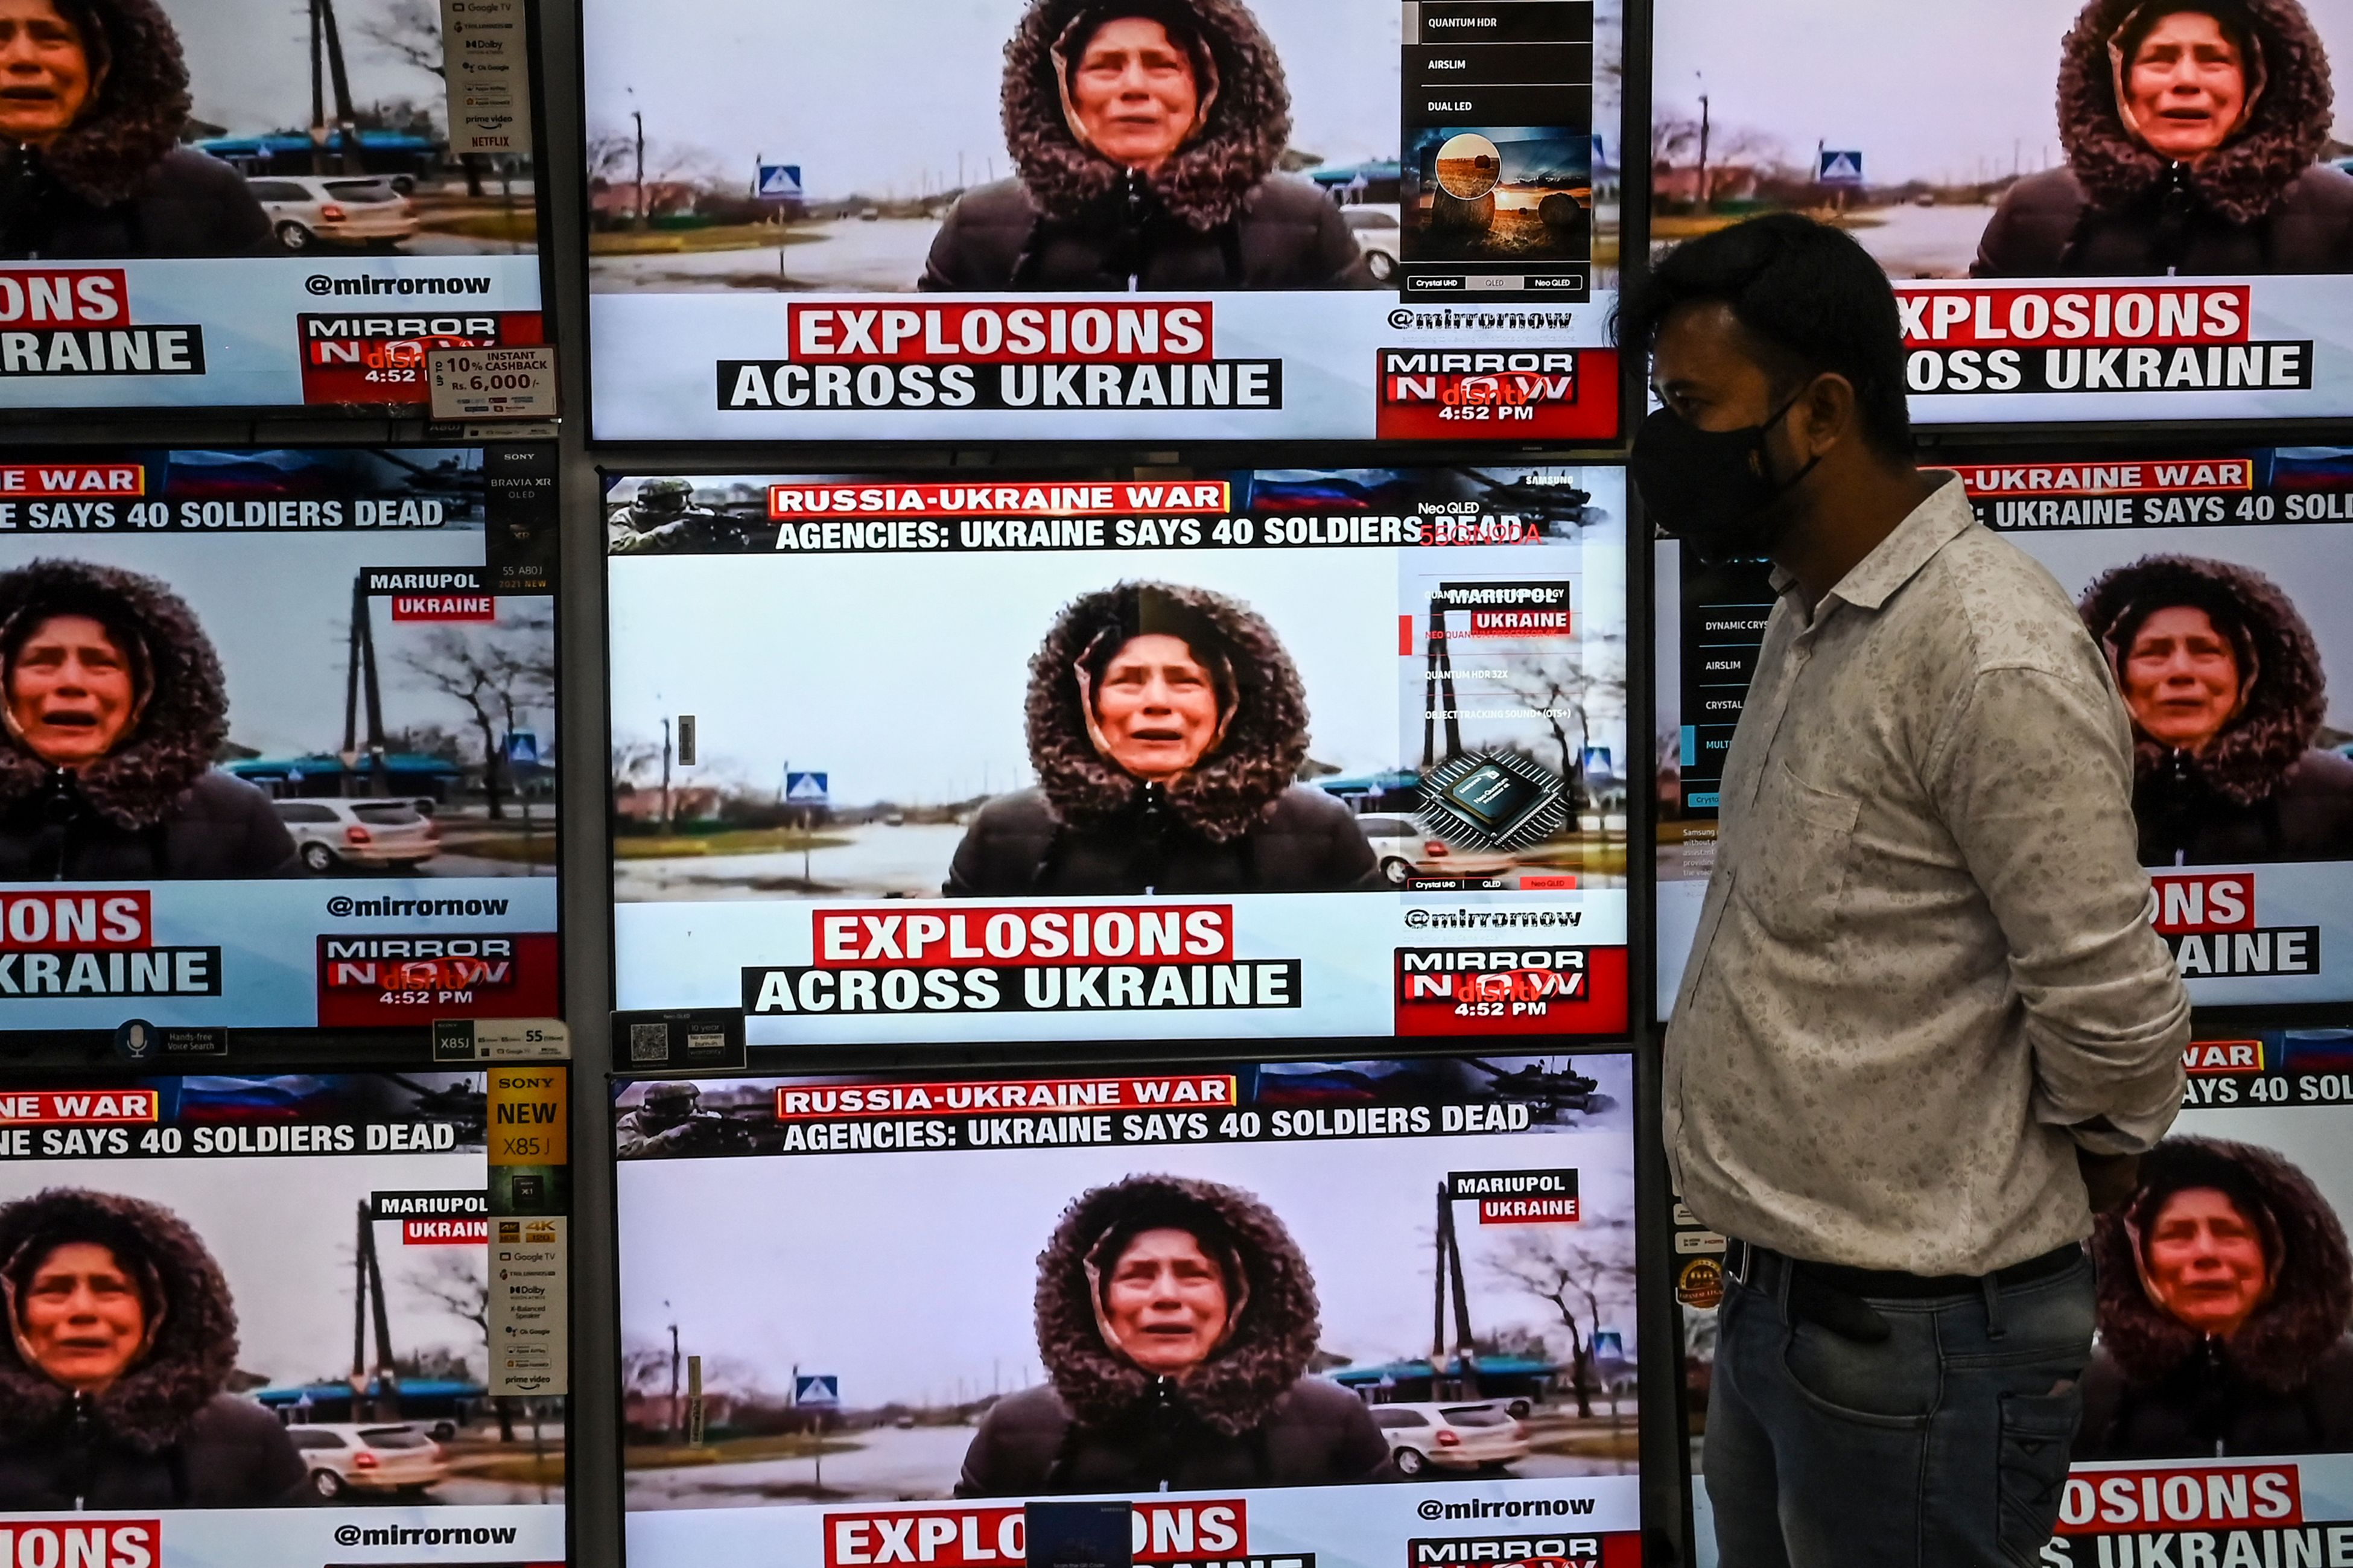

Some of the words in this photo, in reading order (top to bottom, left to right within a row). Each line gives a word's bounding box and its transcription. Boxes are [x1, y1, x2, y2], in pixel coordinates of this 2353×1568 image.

[1428, 18, 1475, 28] QUANTUM
[1478, 18, 1497, 27] HDR
[478, 40, 503, 49] Dolby
[1428, 60, 1466, 69] AIRSLIM
[1428, 102, 1452, 111] DUAL
[1455, 102, 1472, 111] LED
[472, 136, 509, 147] NETFLIX
[305, 274, 491, 296] @mirrornow
[1899, 292, 2241, 340] XPLOSIONS
[309, 318, 495, 337] MIRROR
[799, 309, 1204, 355] EXPLOSIONS
[487, 352, 536, 361] INSTANT
[1387, 354, 1573, 373] MIRROR
[436, 361, 443, 372] TO
[485, 361, 548, 371] CASHBACK
[1905, 349, 2022, 392] OSS
[2045, 346, 2301, 389] UKRAINE
[365, 369, 416, 383] 4:52
[436, 375, 444, 386] UP
[452, 382, 467, 391] Rs.
[730, 364, 976, 407] ACROSS
[1000, 364, 1270, 407] UKRAINE
[1438, 407, 1490, 421] 4:52
[1499, 407, 1534, 421] PM
[39, 470, 134, 490] WAR
[1526, 475, 1573, 485] SAMSUNG
[1964, 466, 2142, 492] -UKRAINE
[2155, 464, 2243, 486] WAR
[778, 487, 1114, 512] RUSSIA-UKRAINE
[1126, 486, 1219, 508] WAR
[29, 502, 115, 528] SAYS
[127, 501, 169, 528] 40
[181, 500, 343, 527] SOLDIERS
[355, 500, 444, 527] DEAD
[1418, 503, 1446, 514] Neo
[1447, 501, 1480, 514] QLED
[1995, 498, 2133, 527] UKRAINE
[2144, 497, 2225, 524] SAYS
[2236, 495, 2275, 521] 40
[776, 521, 950, 550] AGENCIES:
[960, 519, 1105, 548] UKRAINE
[1116, 518, 1202, 546] SAYS
[1211, 518, 1254, 545] 40
[1264, 516, 1423, 544] SOLDIERS
[503, 567, 514, 576] 55
[519, 566, 542, 575] A80J
[370, 574, 480, 589] MARIUPOL
[1449, 588, 1557, 605] MARIUPOL
[399, 597, 490, 613] UKRAINE
[1476, 612, 1567, 628] UKRAINE
[1706, 621, 1746, 630] DYNAMIC
[1425, 631, 1444, 640] NEO
[1706, 661, 1741, 670] AIRSLIM
[1424, 671, 1470, 680] QUANTUM
[1472, 670, 1490, 679] HDR
[1491, 670, 1508, 679] 32X
[1706, 700, 1743, 709] CRYSTAL
[1424, 711, 1458, 720] OBJECT
[1460, 710, 1504, 719] TRACKING
[1415, 881, 1441, 890] Crystal
[326, 896, 509, 917] @mirrornow
[0, 898, 142, 943] ONS
[824, 910, 1225, 960] EXPLOSIONS
[327, 939, 510, 958] MIRROR
[2176, 932, 2308, 974] AINE
[1404, 951, 1584, 971] MIRROR
[755, 968, 1000, 1012] ACROSS
[1024, 964, 1289, 1008] UKRAINE
[379, 991, 429, 1004] 4:52
[439, 991, 472, 1003] PM
[1455, 1002, 1504, 1017] 4:52
[1513, 1002, 1546, 1016] PM
[170, 1033, 212, 1041] Hands-free
[441, 1037, 469, 1049] X85J
[526, 1030, 543, 1043] 55
[190, 1042, 215, 1050] Search
[499, 1078, 554, 1088] SONY
[2181, 1078, 2238, 1104] AYS
[2250, 1077, 2288, 1102] 40
[786, 1082, 1120, 1114] RUSSIA-UKRAINE
[1132, 1080, 1226, 1103] WAR
[53, 1095, 147, 1117] WAR
[497, 1103, 557, 1124] NEW
[783, 1120, 956, 1151] AGENCIES:
[968, 1116, 1112, 1145] UKRAINE
[1123, 1113, 1208, 1141] SAYS
[1219, 1111, 1261, 1138] 40
[1271, 1106, 1431, 1137] SOLDIERS
[1442, 1103, 1529, 1132] DEAD
[42, 1128, 129, 1155] SAYS
[140, 1128, 182, 1154] 40
[193, 1125, 355, 1154] SOLDIERS
[366, 1123, 454, 1151] DEAD
[1458, 1176, 1566, 1194] MARIUPOL
[381, 1197, 488, 1213] MARIUPOL
[1485, 1200, 1575, 1217] UKRAINE
[408, 1221, 487, 1238] UKRAIN
[525, 1220, 556, 1231] 4K
[514, 1252, 542, 1262] Google
[521, 1286, 545, 1295] Dolby
[506, 1376, 528, 1384] prime
[2059, 1472, 2292, 1525] OSIONS
[1417, 1498, 1595, 1520] @mirrornow
[334, 1525, 516, 1546] @mirrornow
[835, 1506, 1239, 1566] EXPLONS
[1418, 1537, 1597, 1562] MIRROR
[2097, 1527, 2353, 1568] UKRAINE
